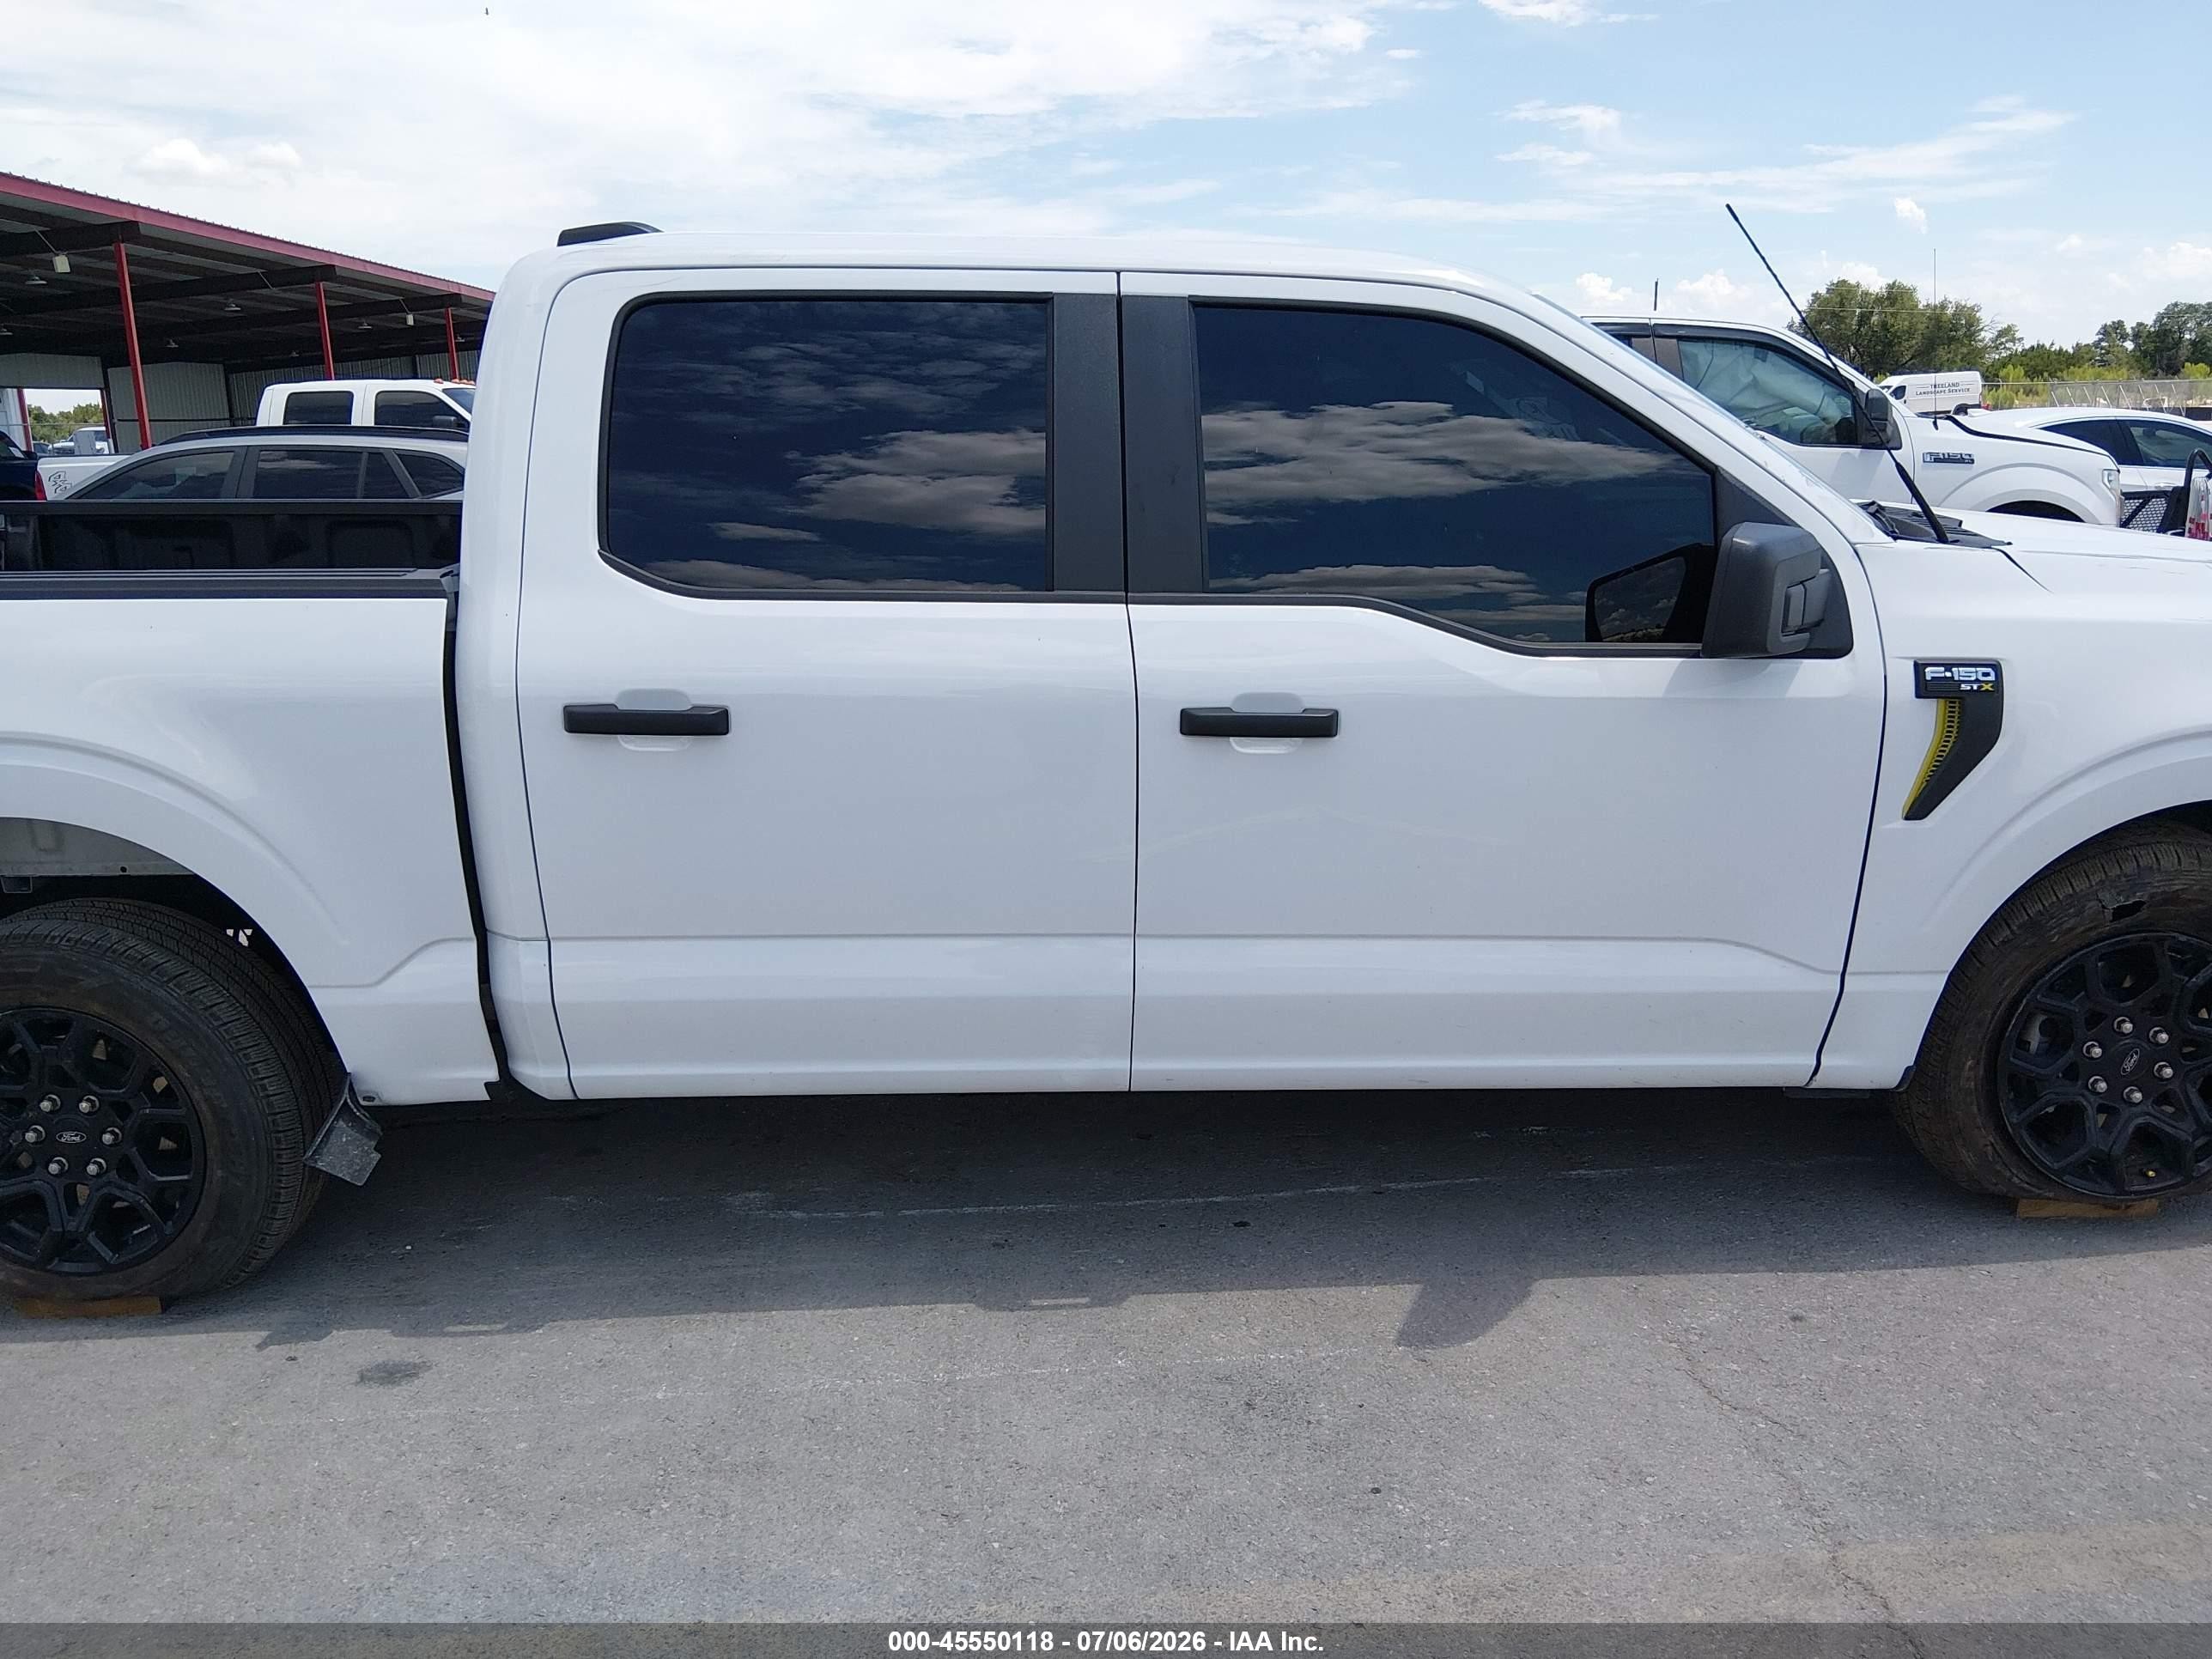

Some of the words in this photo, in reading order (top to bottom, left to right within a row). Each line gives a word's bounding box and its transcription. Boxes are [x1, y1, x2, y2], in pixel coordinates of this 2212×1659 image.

[1924, 666, 1996, 681] F-150
[2123, 1052, 2137, 1072] Ford
[61, 1133, 81, 1141] Ford
